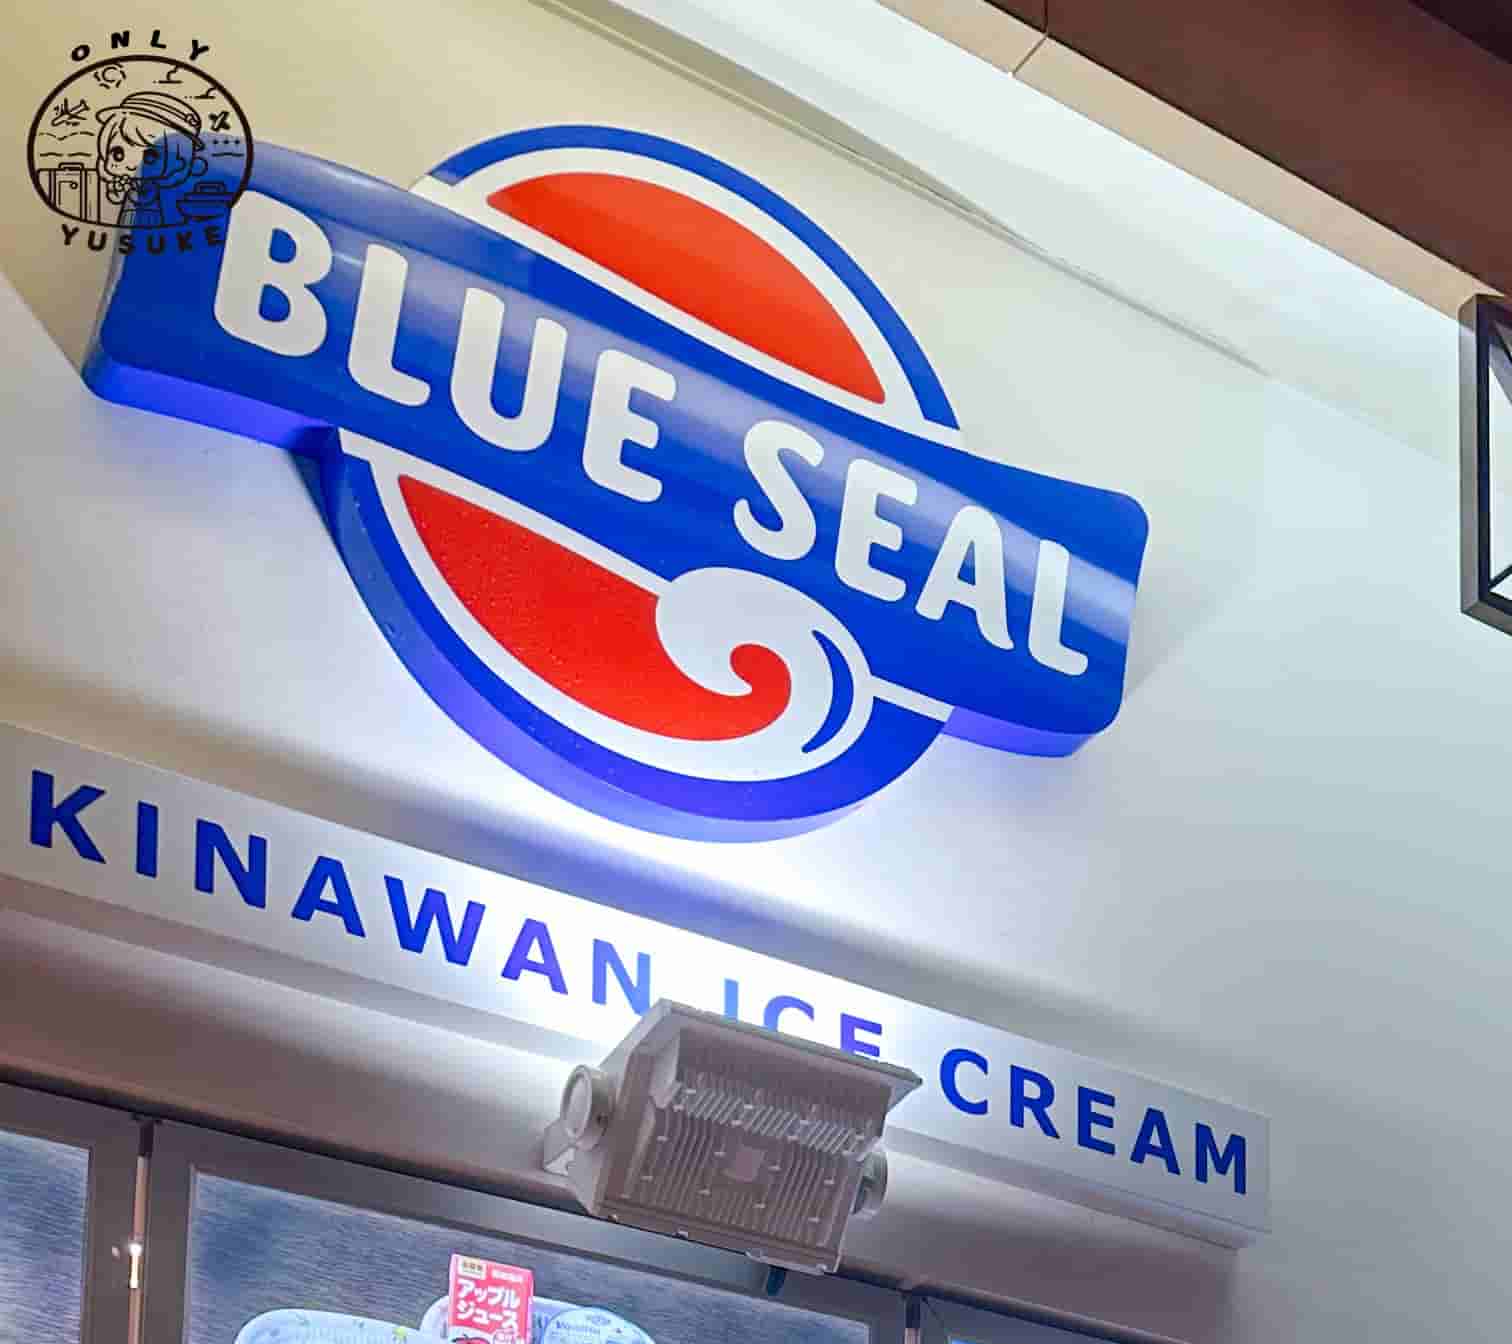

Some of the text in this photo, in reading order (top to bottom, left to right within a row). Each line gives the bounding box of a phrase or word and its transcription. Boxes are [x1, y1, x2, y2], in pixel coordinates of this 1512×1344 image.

[213, 189, 1090, 677] BLUE SEAL
[28, 767, 653, 1017] KINAWAN
[938, 1047, 1249, 1196] CREAM
